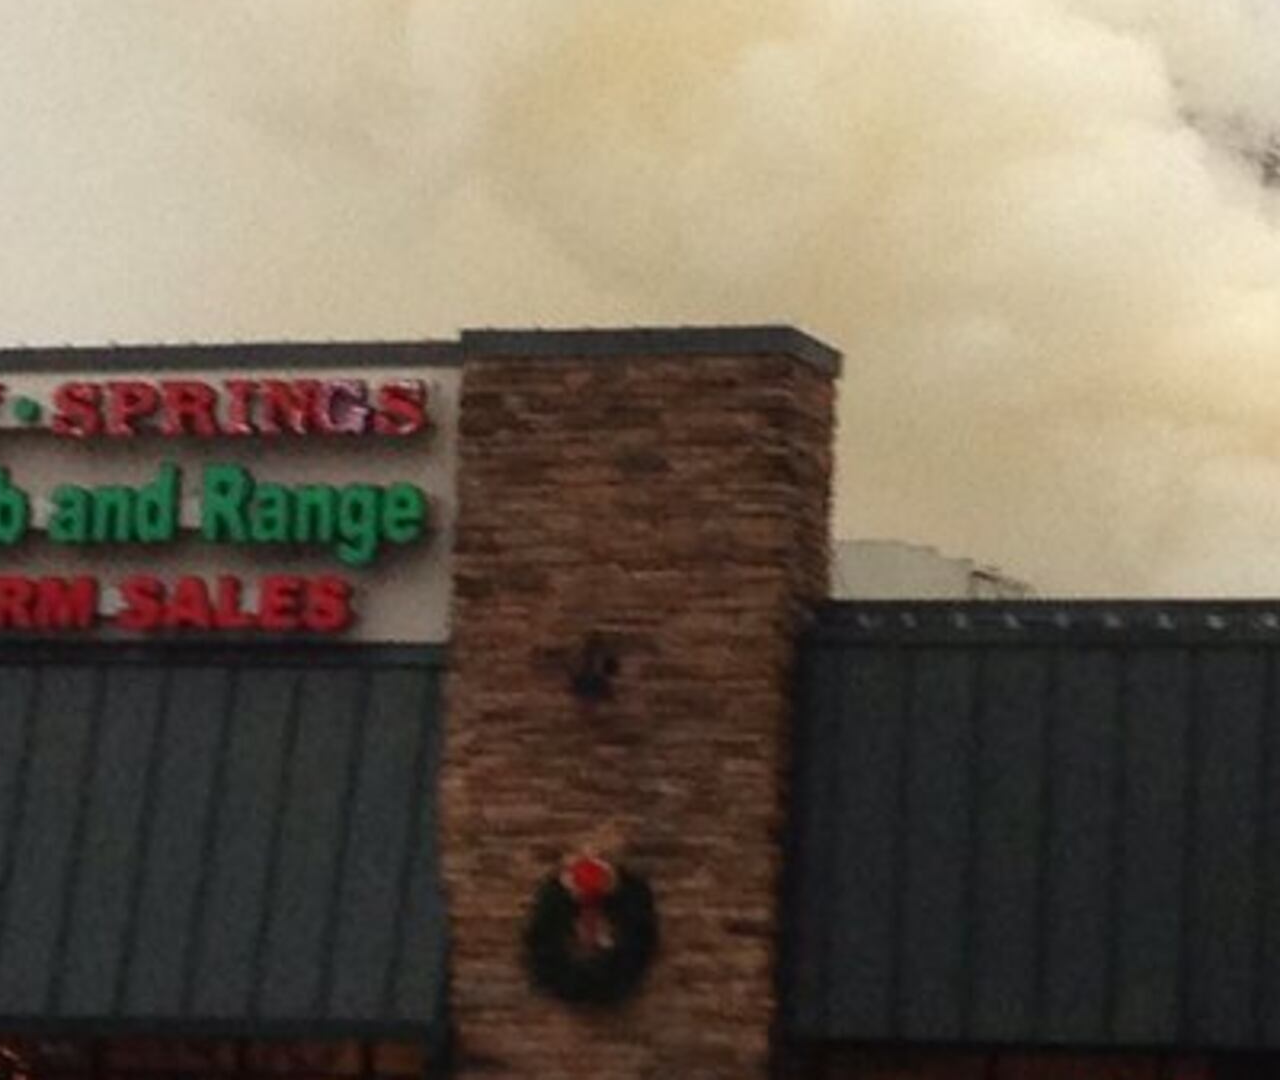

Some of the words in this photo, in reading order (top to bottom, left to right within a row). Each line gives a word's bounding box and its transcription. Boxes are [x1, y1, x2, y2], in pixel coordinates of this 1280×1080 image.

[53, 378, 426, 435] SPRINGS
[48, 463, 178, 542] and
[201, 464, 424, 563] Range
[118, 575, 352, 630] SALES
